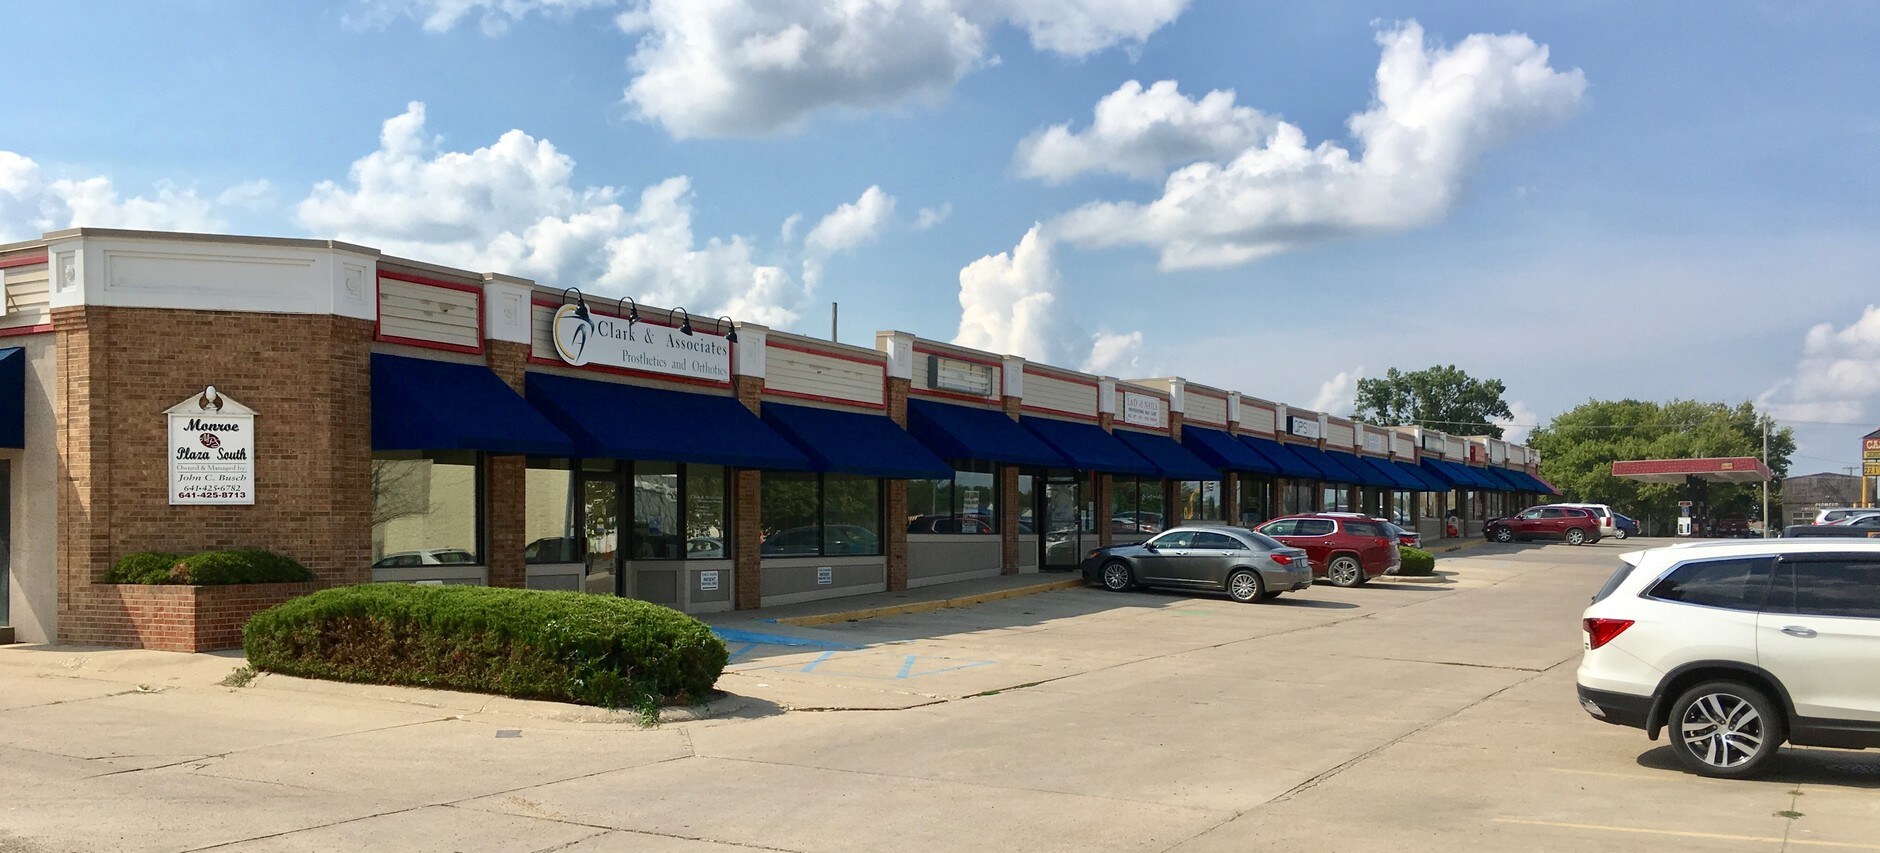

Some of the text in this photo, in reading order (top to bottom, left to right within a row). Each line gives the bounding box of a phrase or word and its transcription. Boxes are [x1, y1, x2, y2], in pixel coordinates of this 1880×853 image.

[597, 320, 727, 356] Clark & Associates
[622, 349, 727, 376] Prosthetics and Orthotics
[183, 419, 239, 431] Monroe
[176, 447, 247, 460] Plaza South
[208, 464, 236, 472] Managed
[178, 474, 202, 482] John
